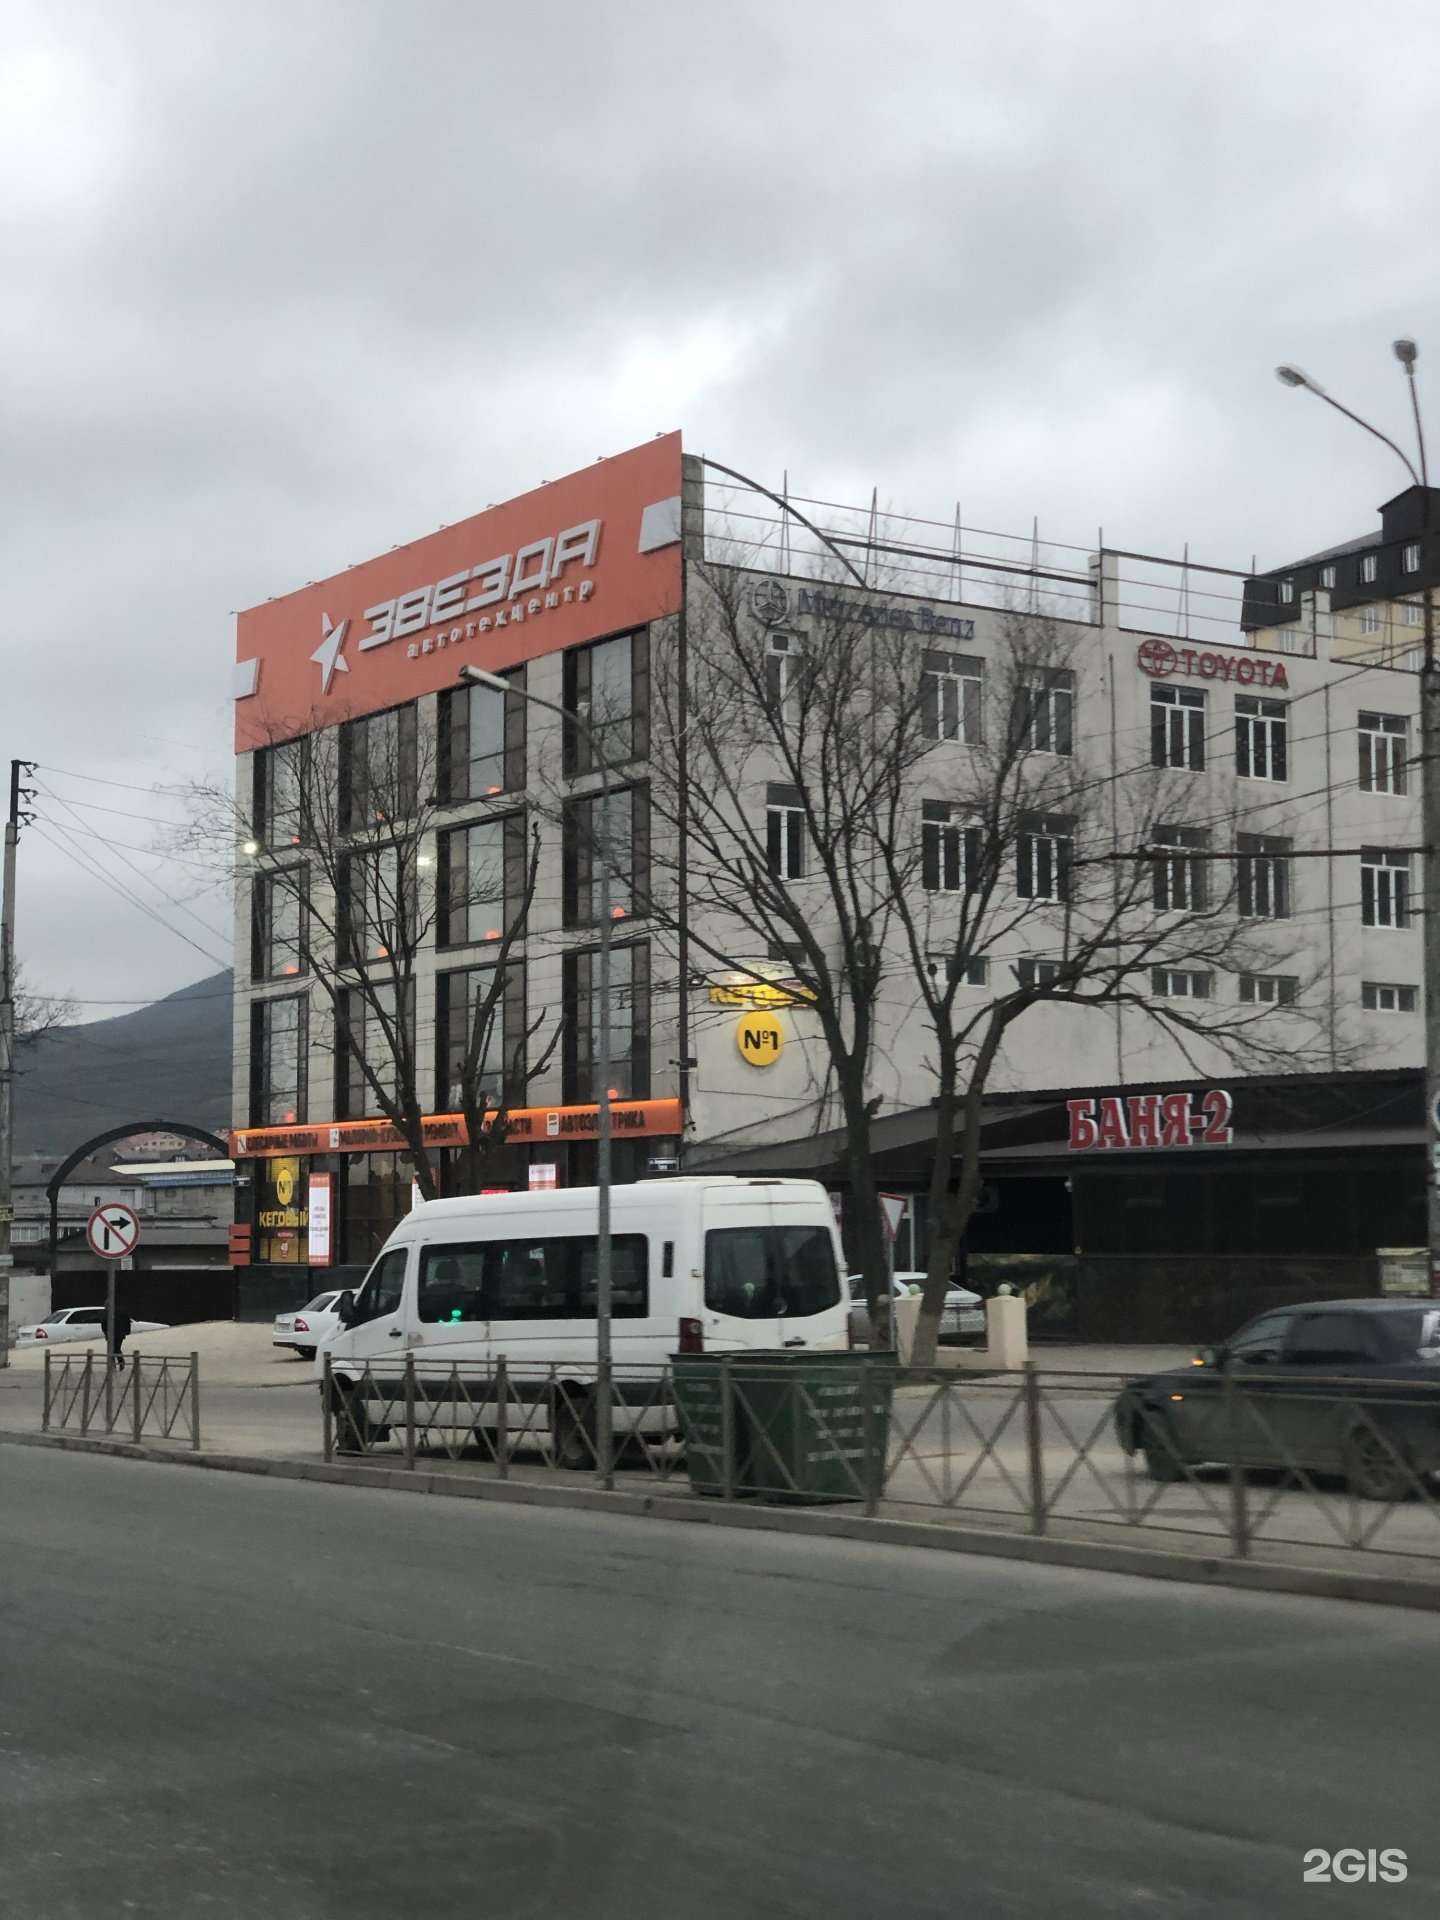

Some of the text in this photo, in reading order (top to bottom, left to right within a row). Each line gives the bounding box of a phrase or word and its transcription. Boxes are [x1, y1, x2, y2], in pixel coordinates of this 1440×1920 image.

[358, 519, 601, 651] ЗВЕЗДА
[407, 579, 594, 658] автотехцентр
[1181, 648, 1289, 690] TOYOTA
[1066, 1089, 1234, 1150] БАНЯ-2
